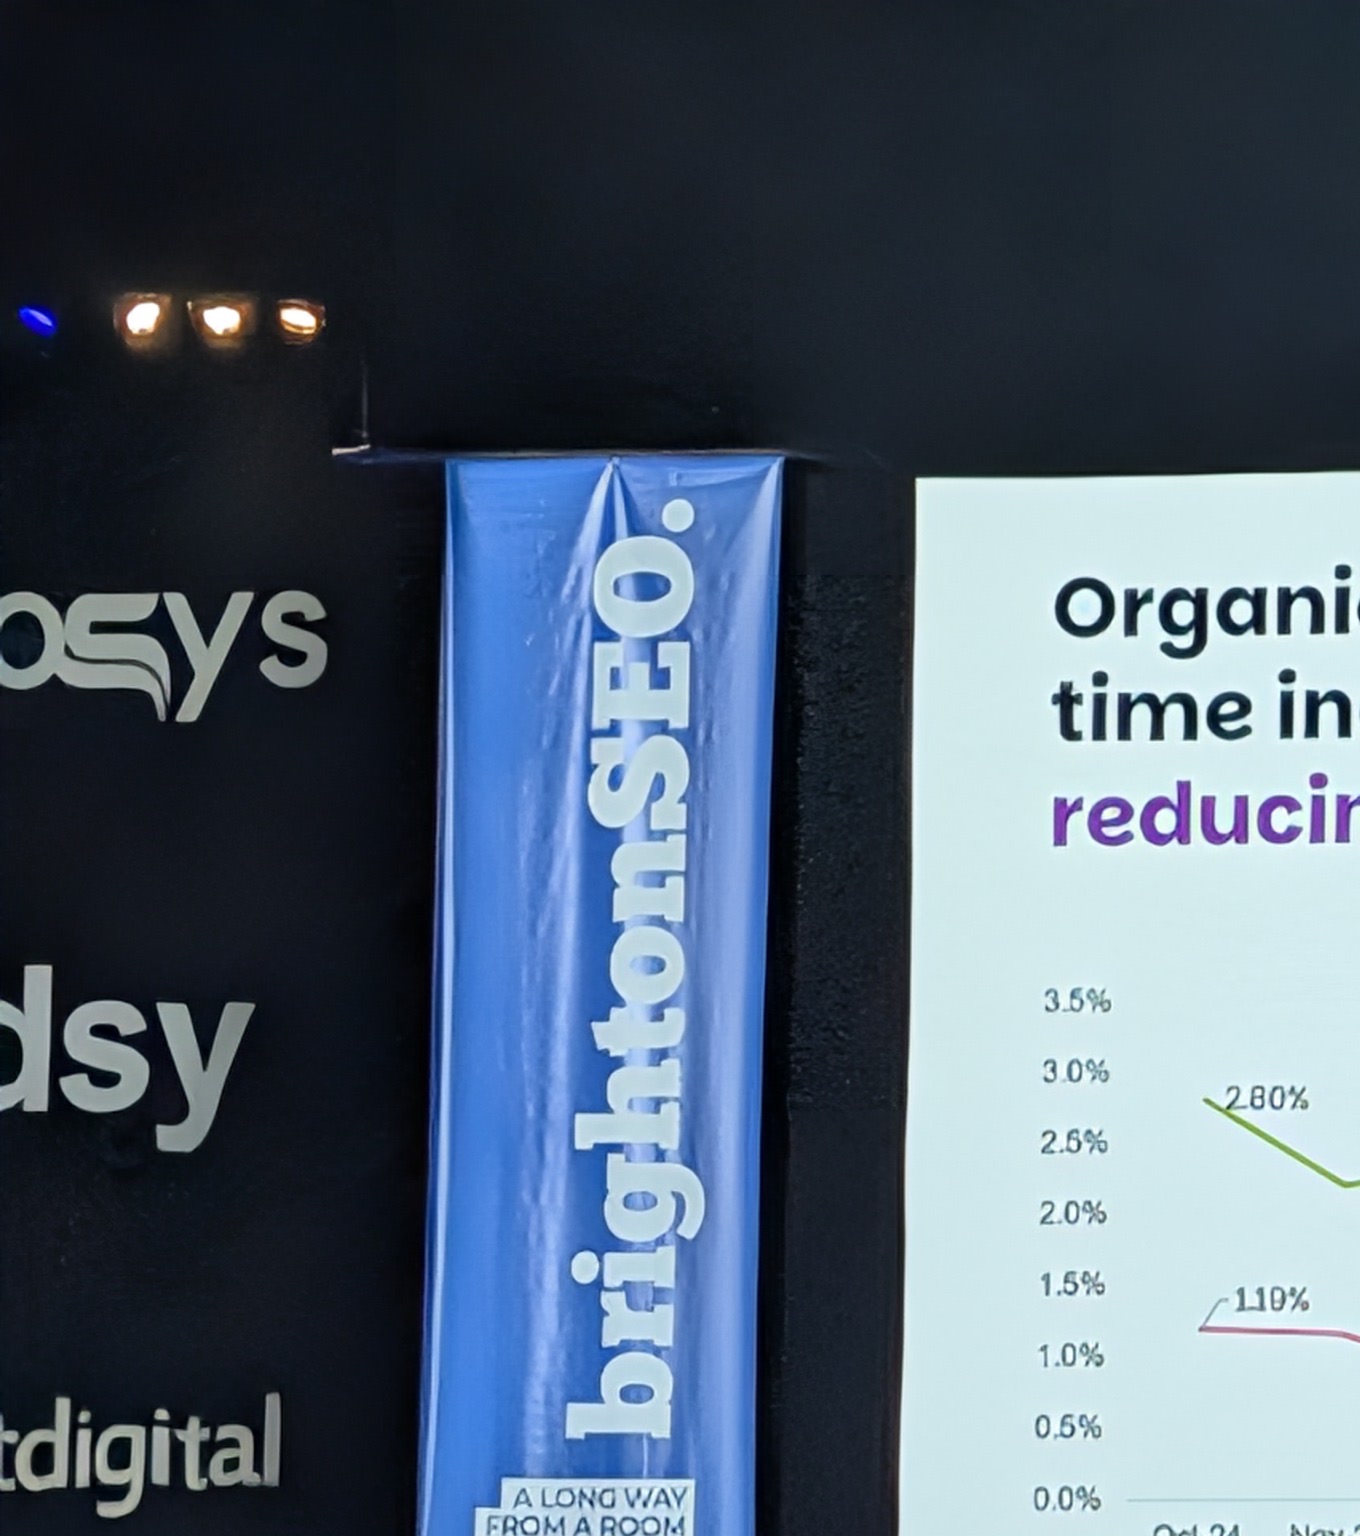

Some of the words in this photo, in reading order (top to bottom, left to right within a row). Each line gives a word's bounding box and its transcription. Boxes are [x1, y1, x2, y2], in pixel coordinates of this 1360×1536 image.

[1051, 671, 1252, 741] time
[566, 498, 704, 1440] brightonSEO.
[1044, 987, 1112, 1014] 3.5%
[1042, 1058, 1110, 1084] 3.0%
[1040, 1128, 1109, 1155] 2.5%
[1039, 1199, 1108, 1226] 2.0%
[1040, 1270, 1106, 1297] 1.5%
[1038, 1342, 1105, 1368] 1.0%
[1034, 1413, 1103, 1440] 0.5%
[513, 1487, 533, 1509] A
[541, 1487, 617, 1510] LONG
[624, 1486, 688, 1510] WAY
[1033, 1485, 1102, 1512] 0.0%
